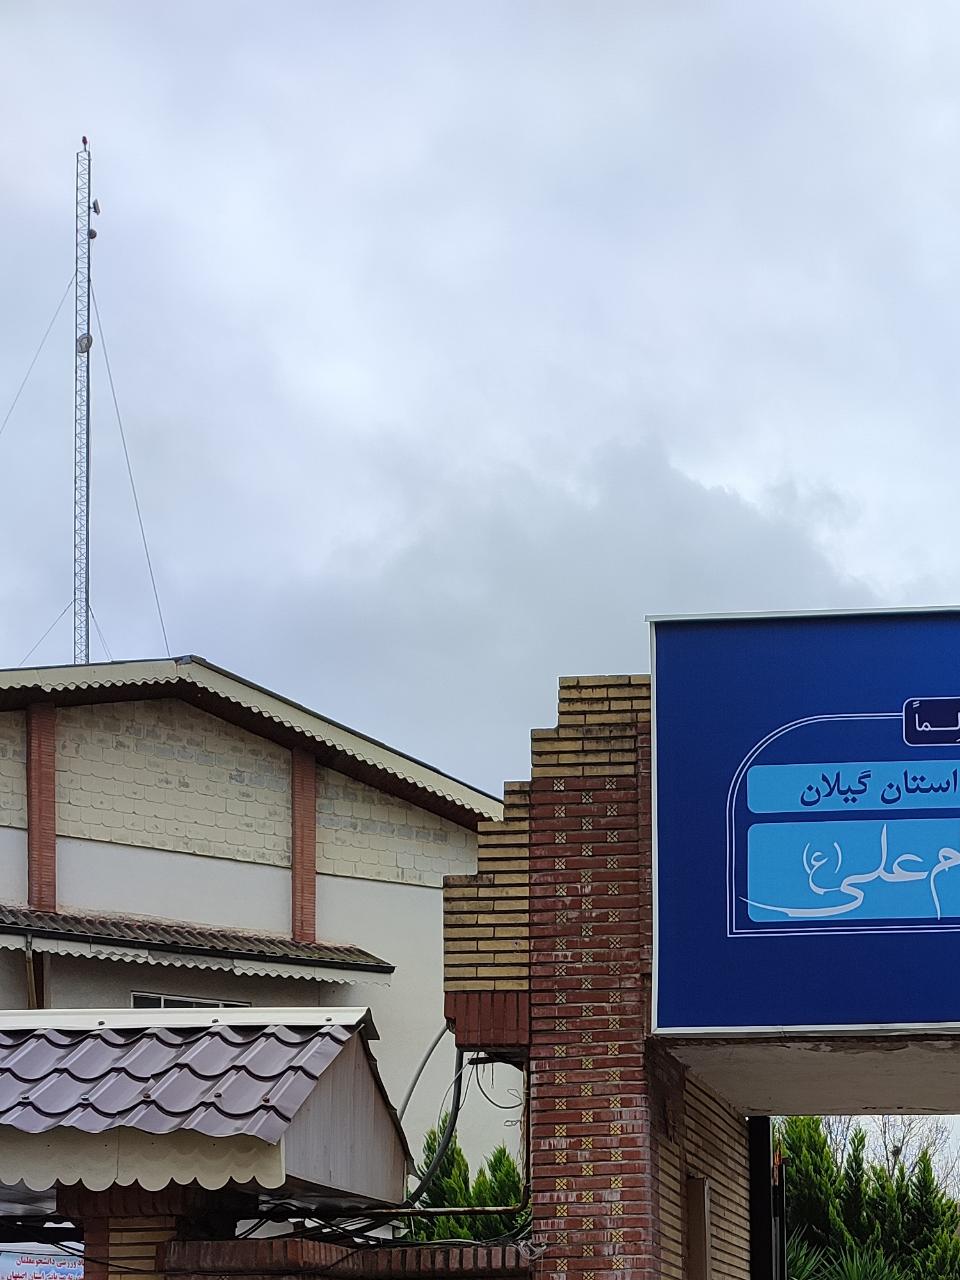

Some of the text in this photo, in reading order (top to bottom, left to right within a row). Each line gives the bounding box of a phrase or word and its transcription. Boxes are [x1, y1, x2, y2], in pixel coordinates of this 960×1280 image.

[799, 769, 872, 807] گیلان
[879, 768, 958, 805] استان
[739, 823, 928, 918] علی
